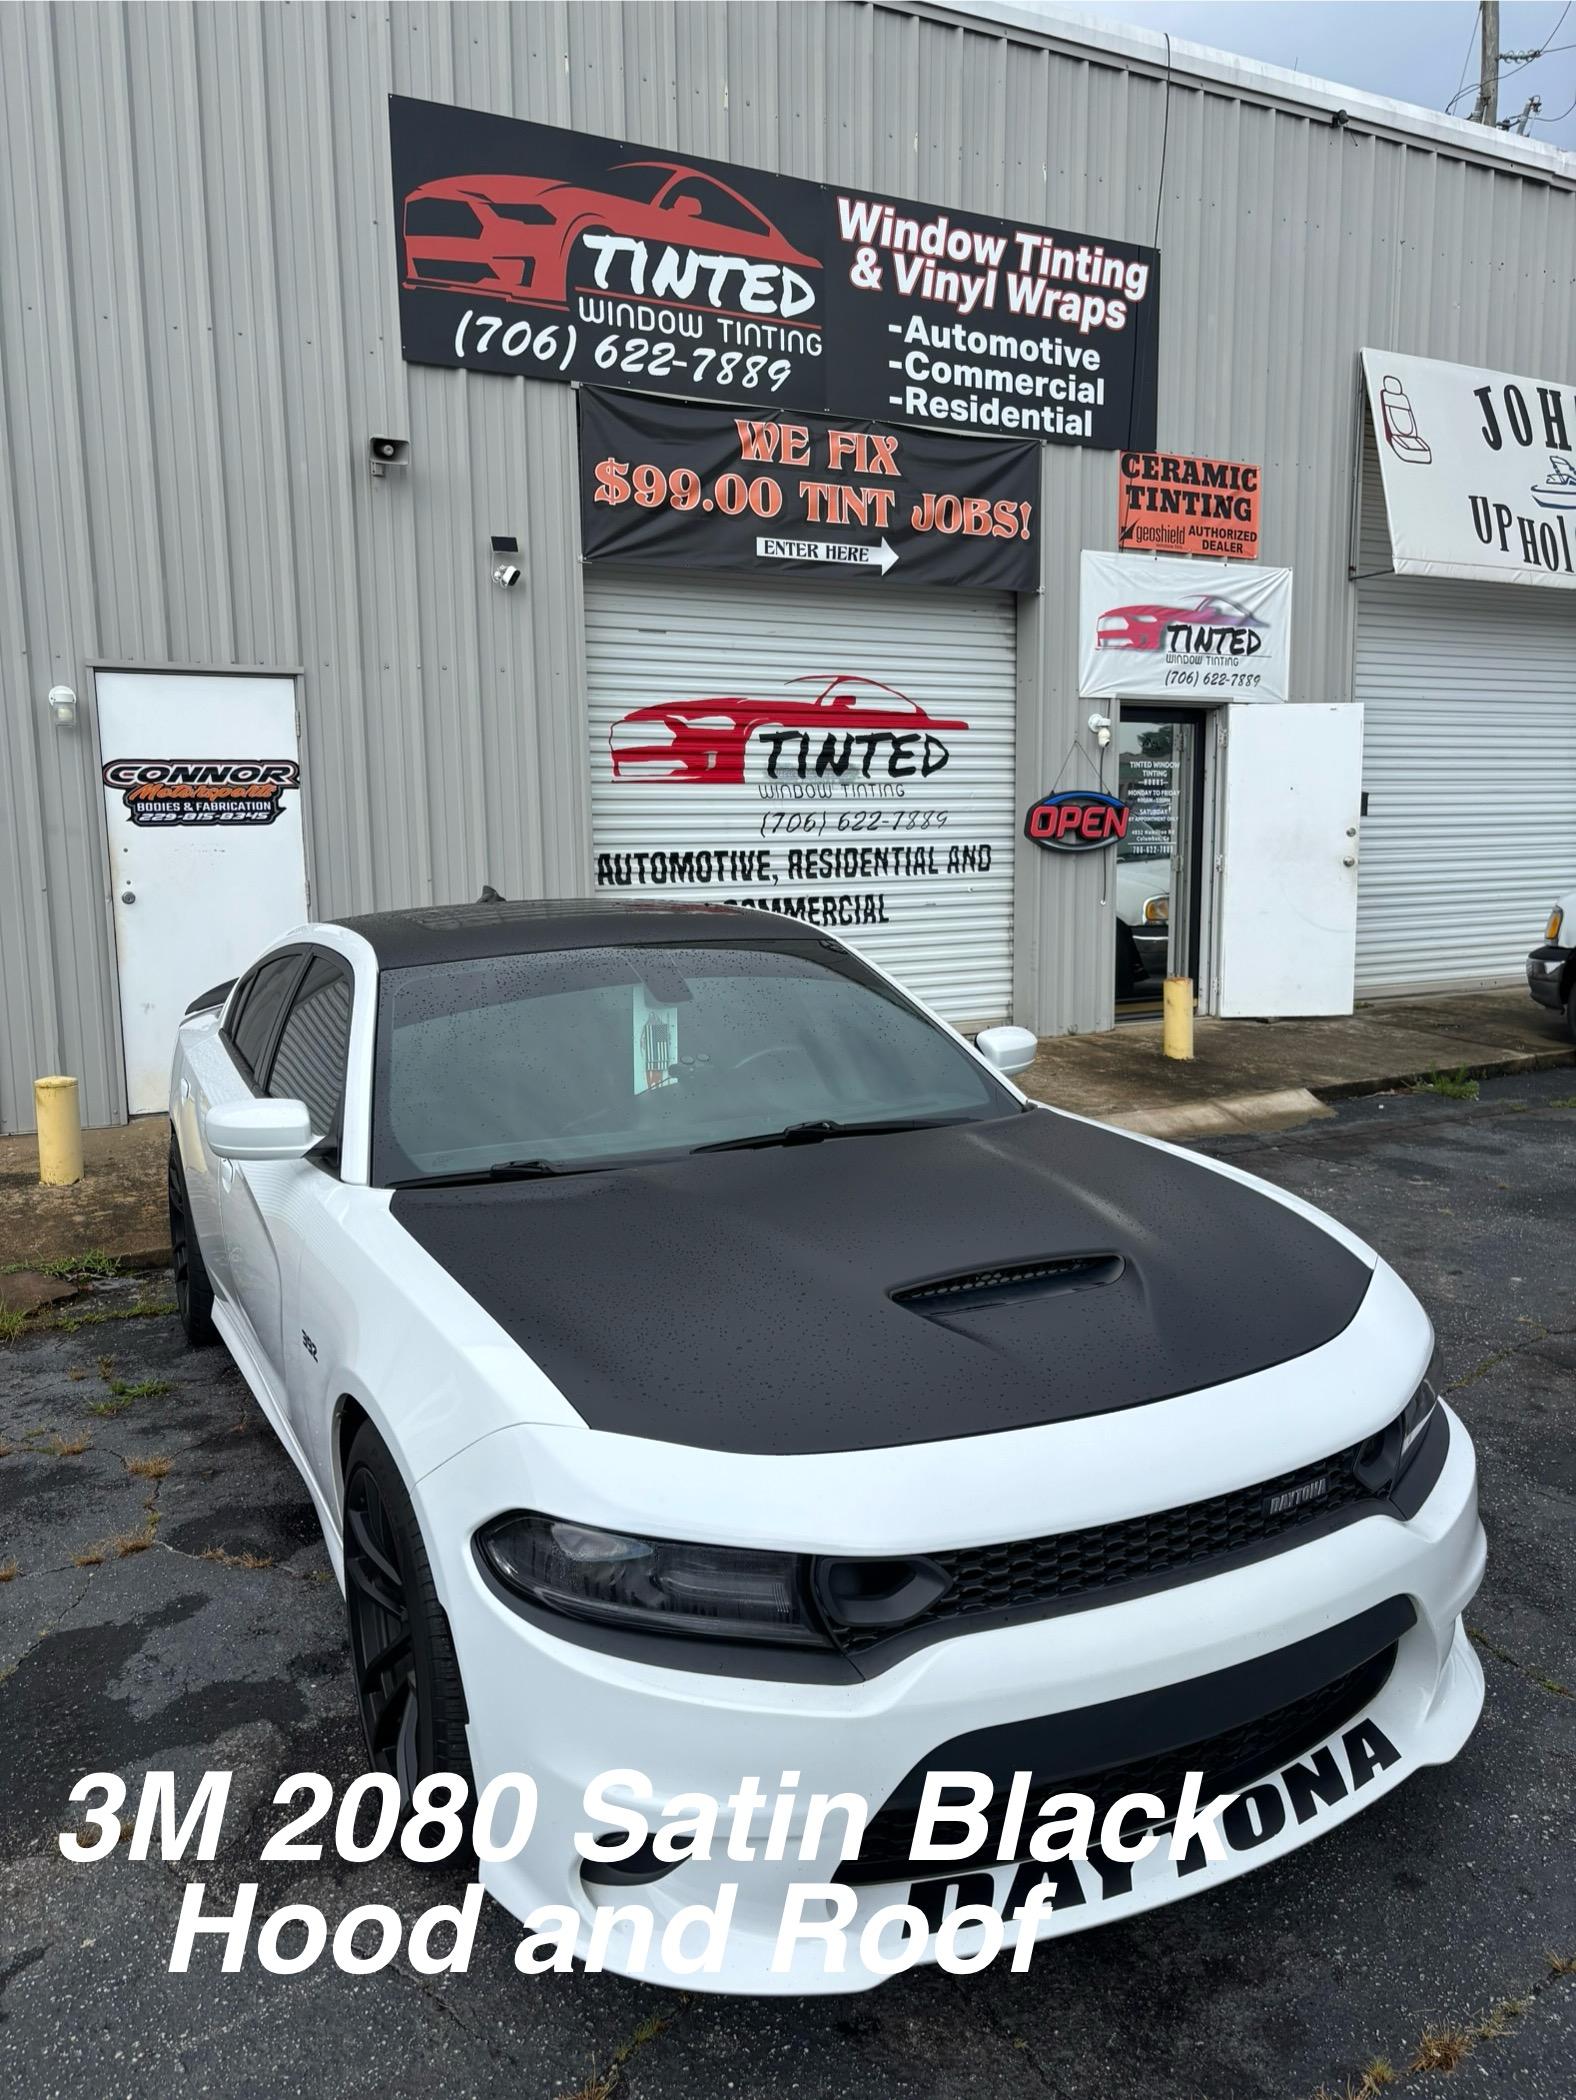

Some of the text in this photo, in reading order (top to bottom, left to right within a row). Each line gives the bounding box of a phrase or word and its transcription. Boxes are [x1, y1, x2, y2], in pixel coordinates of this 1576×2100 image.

[837, 197, 1149, 299] Window Tinting
[582, 234, 816, 318] TINTED
[850, 249, 1128, 334] & Vinyl Wraps
[578, 297, 822, 357] WINDOW TINTING
[889, 315, 1100, 372] -Automotive
[454, 310, 792, 392] (706) 622-7889
[889, 351, 1105, 405] -Commercial
[889, 386, 1093, 437] -Residential
[1473, 384, 1576, 452] JOH
[734, 418, 901, 476] WE FIX
[1121, 453, 1257, 492] CERAMIC
[594, 457, 1033, 540] $99.00 TINT JOBS!
[1126, 485, 1252, 522] TINTING
[764, 540, 869, 562] ENTER HERE
[1136, 525, 1185, 545] geoshield
[1188, 525, 1257, 542] AUTHORIZED
[1202, 540, 1243, 553] DEALER
[1167, 624, 1262, 656] TINTED
[1165, 671, 1261, 688] (706) 622-7889
[1166, 654, 1239, 667] WINDOW TINTING
[759, 730, 950, 779] TINTED
[108, 765, 295, 785] CONNOR
[758, 784, 905, 799] WINDOW TINTING
[137, 801, 271, 812] BODIES & FABRICATION
[760, 810, 949, 838] (706) 622-7889
[1030, 805, 1130, 839] OPEN
[597, 844, 992, 886] AUTOMOTIVE, RESIDENTIAL AND
[724, 894, 889, 926] MMERCIAL
